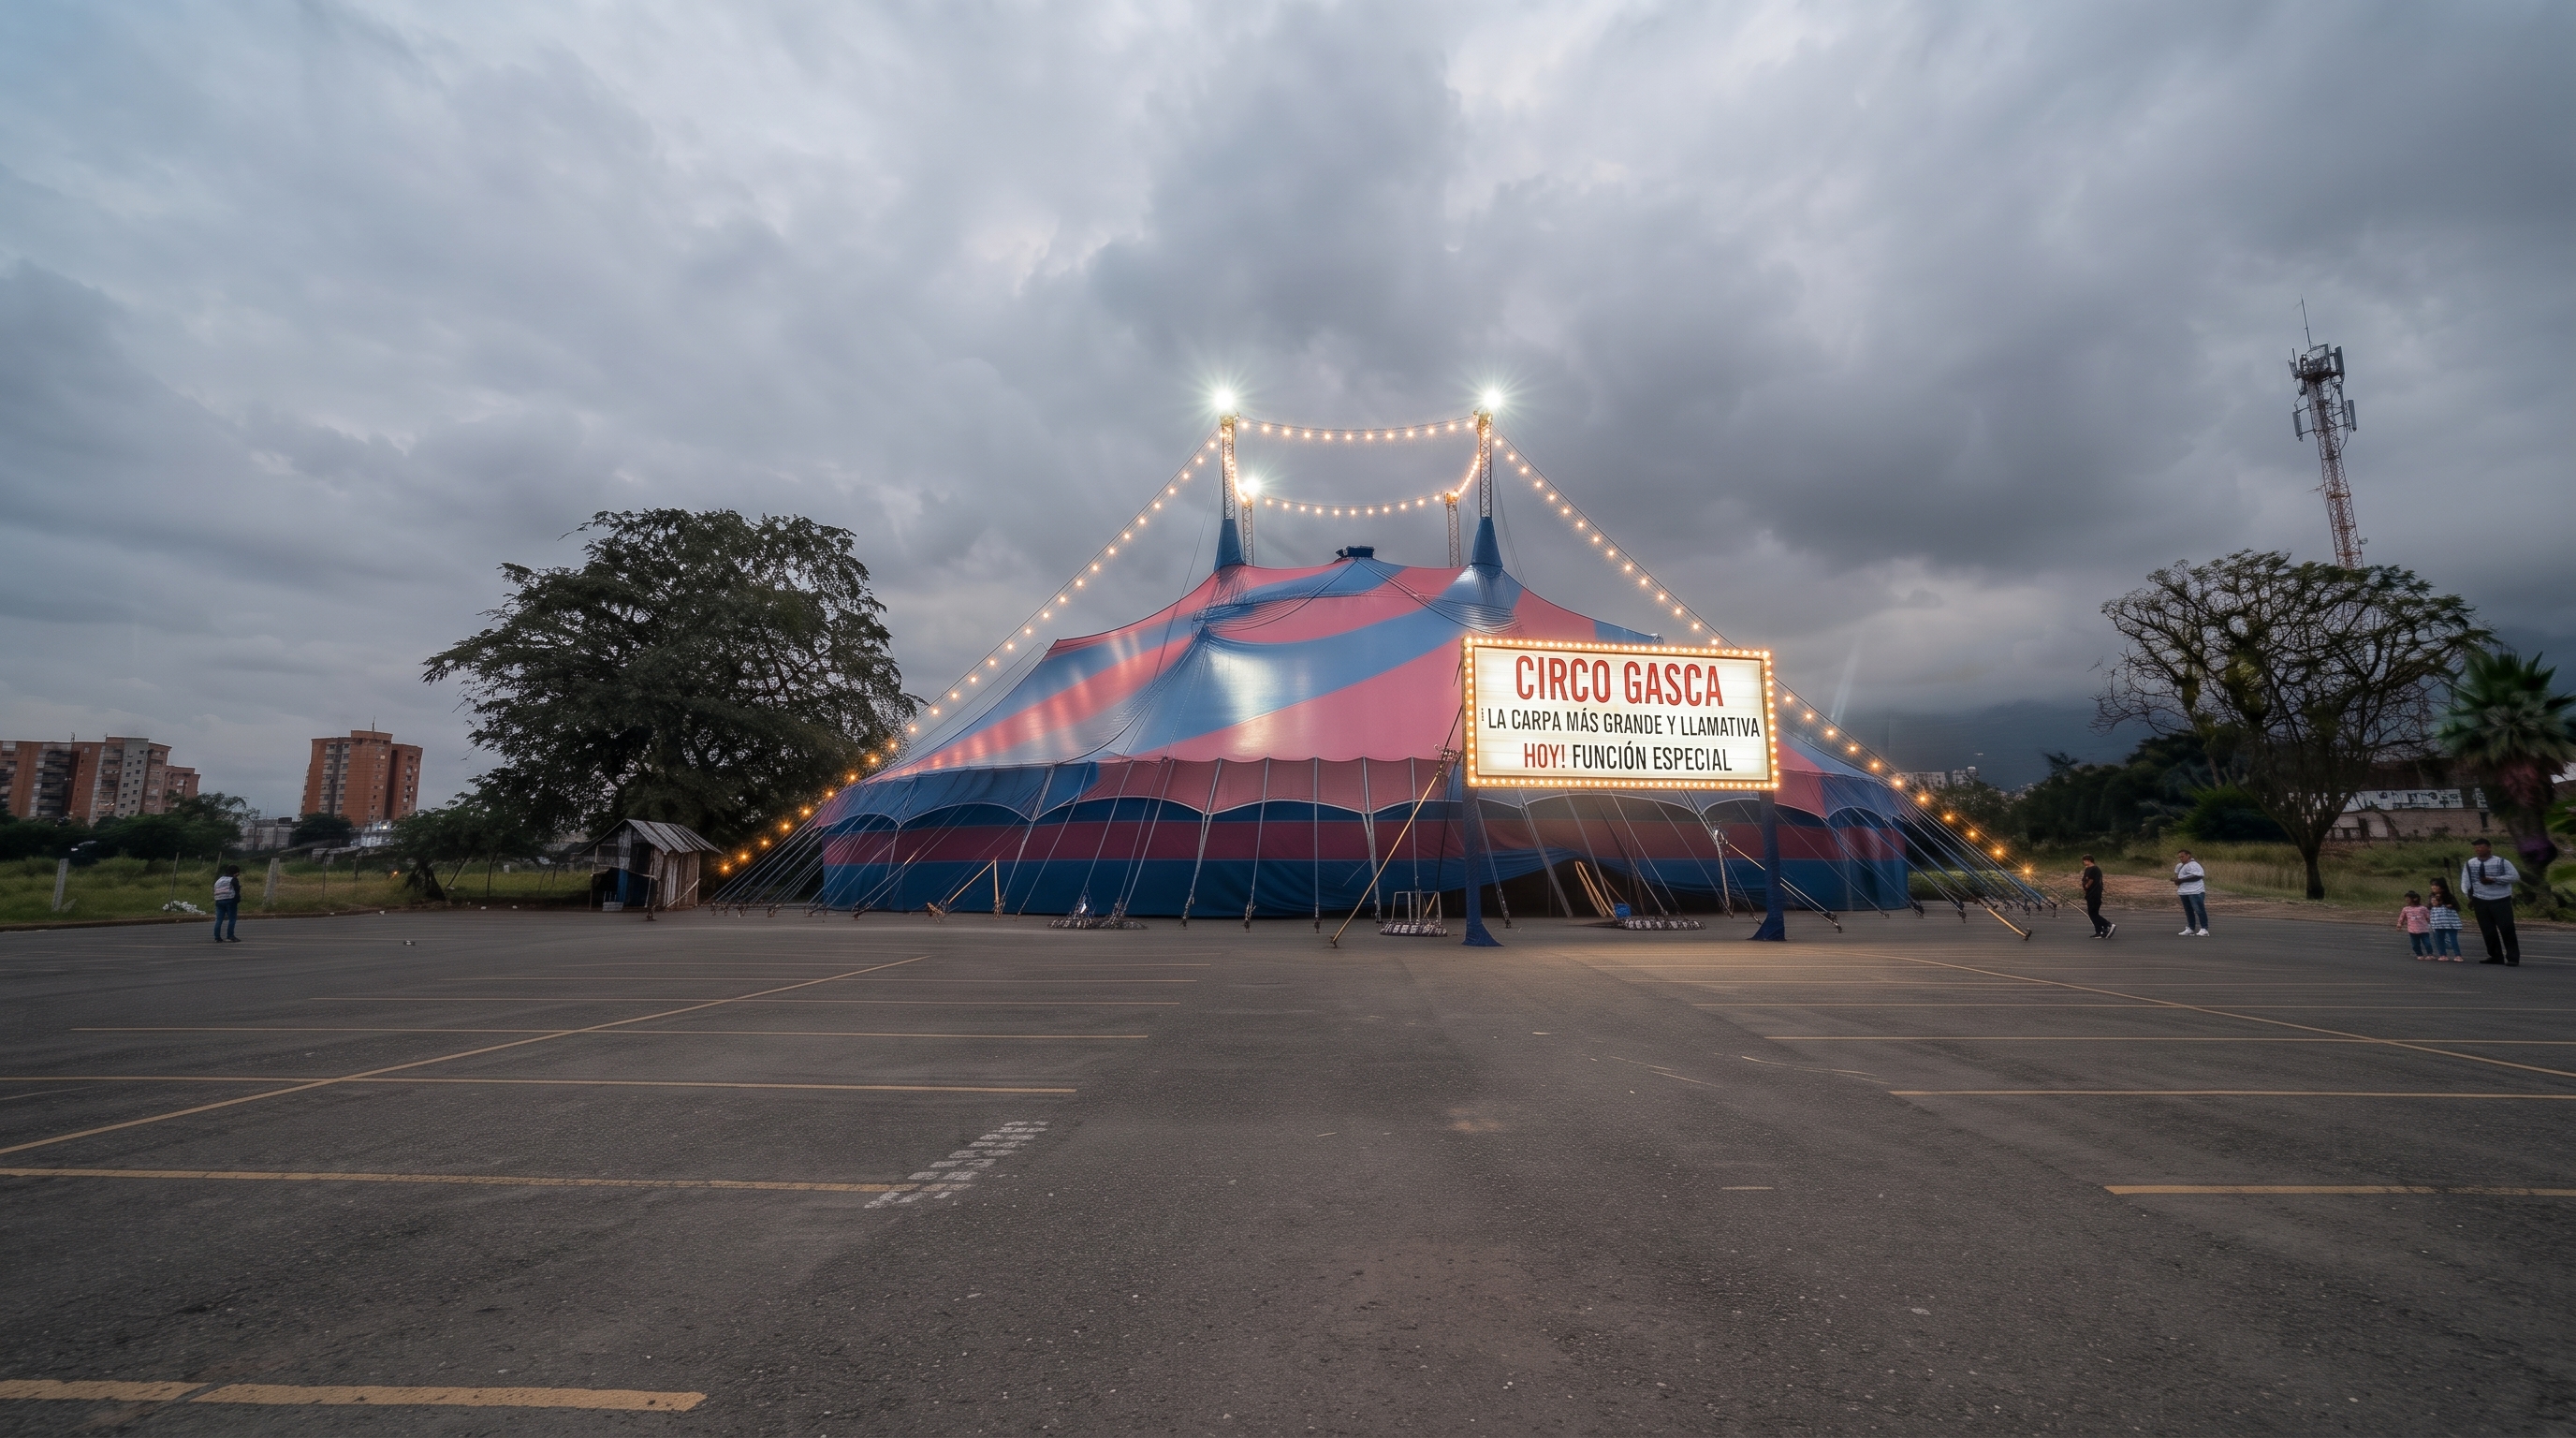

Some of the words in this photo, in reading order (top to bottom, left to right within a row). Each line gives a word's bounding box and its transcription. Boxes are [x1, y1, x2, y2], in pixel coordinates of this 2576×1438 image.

[1515, 655, 1612, 704] CIRCO
[1623, 660, 1725, 708] GASCA
[1511, 709, 1562, 732] CARPA
[1566, 708, 1599, 733] MÁS
[1603, 712, 1663, 735] GRANDE
[1666, 716, 1676, 736] Y
[1680, 715, 1761, 738] LLAMATIVA
[1524, 742, 1566, 769] HOY!
[1572, 740, 1647, 770] FUNCIÓN
[1653, 746, 1733, 771] ESPECIAL
